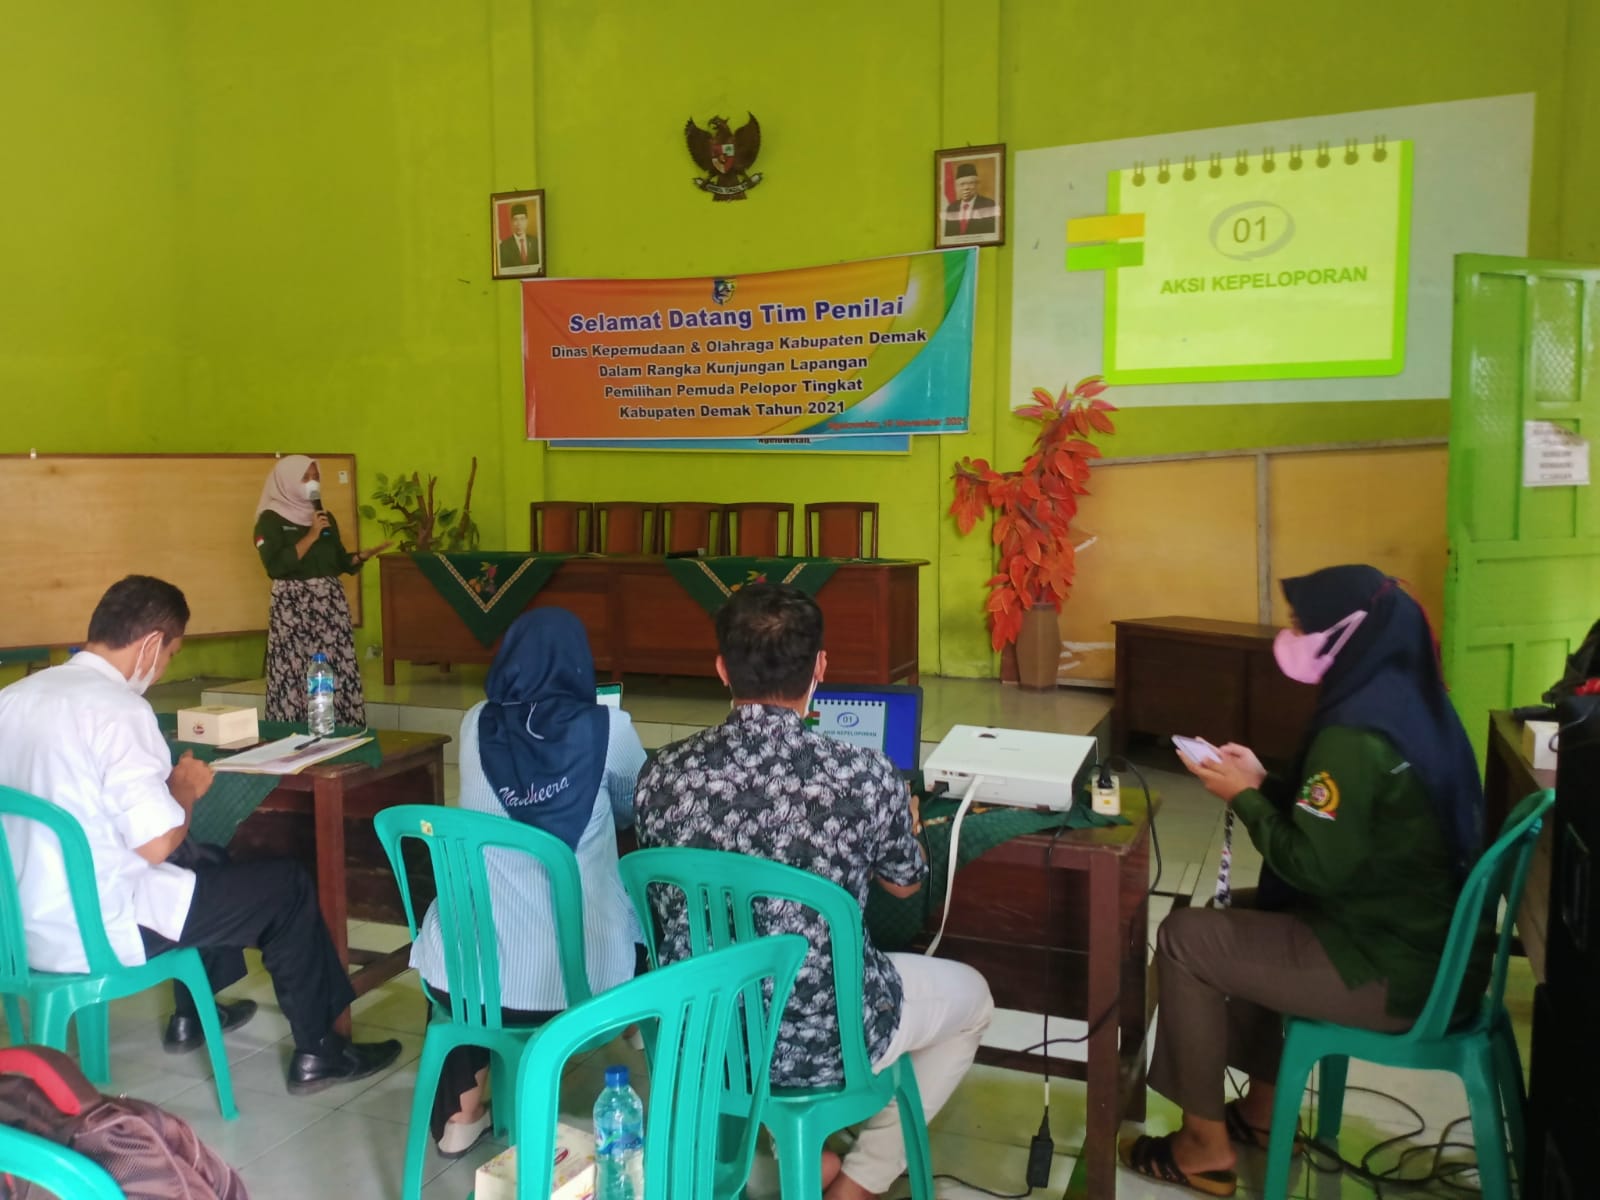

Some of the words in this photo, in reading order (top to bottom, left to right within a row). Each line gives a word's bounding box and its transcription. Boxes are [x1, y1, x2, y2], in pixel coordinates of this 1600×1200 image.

[1232, 215, 1267, 244] 01
[1159, 277, 1205, 295] AKSI
[1211, 265, 1369, 292] KEPELOPORAN
[569, 312, 662, 333] Selamat
[669, 307, 752, 329] Datang
[760, 304, 806, 323] Tim
[815, 297, 904, 320] Penilai
[552, 346, 588, 358] Dinas
[592, 343, 685, 358] Kepemudaan
[691, 341, 701, 353] &
[706, 338, 774, 353] Olahraga
[779, 334, 864, 350] Kabupaten
[869, 329, 927, 345] Demak
[599, 365, 642, 377] Dalam
[647, 363, 701, 378] Rangka
[706, 360, 785, 376] Kunjungan
[790, 357, 868, 372] Lapangan
[605, 385, 672, 398] Pemilihan
[676, 384, 735, 396] Pemuda
[740, 382, 798, 396] Pelopor
[802, 379, 863, 395] Tingkat
[620, 406, 696, 420] Kabupaten
[700, 404, 751, 417] Demak
[756, 403, 803, 416] Tahun
[808, 401, 845, 414] 2021
[843, 716, 853, 724] 01
